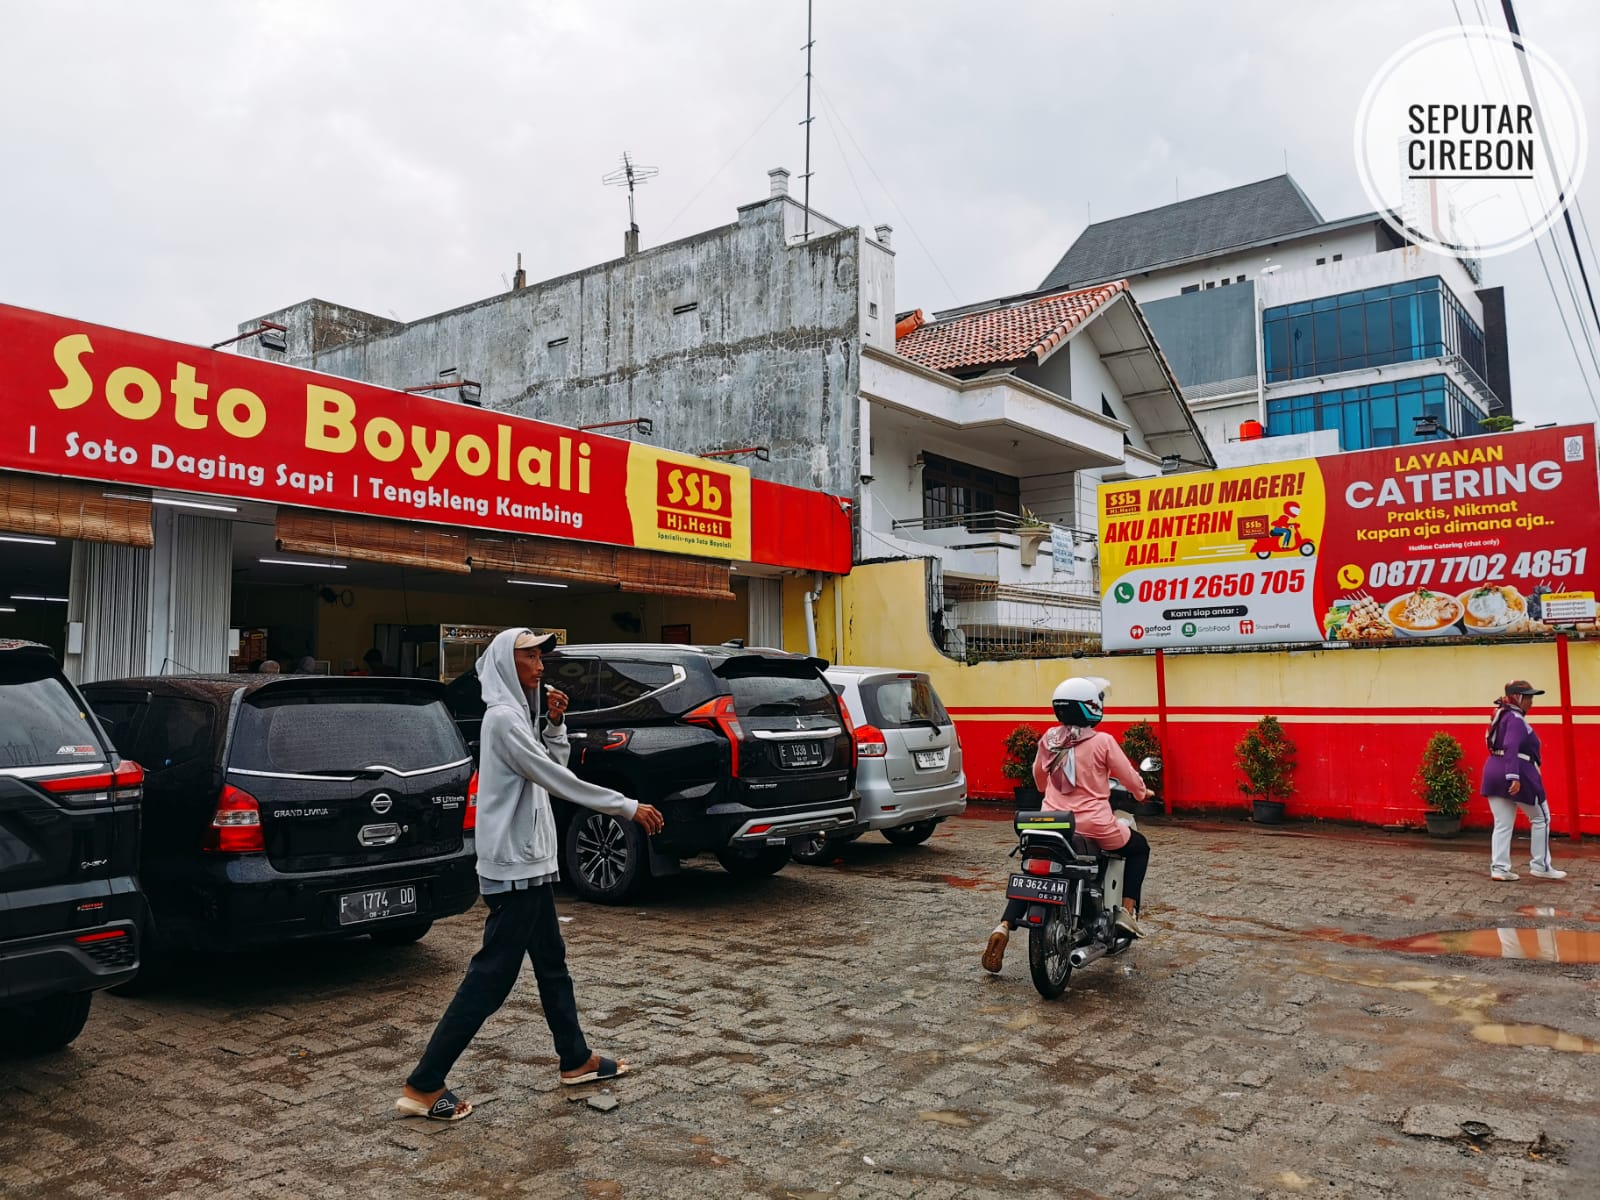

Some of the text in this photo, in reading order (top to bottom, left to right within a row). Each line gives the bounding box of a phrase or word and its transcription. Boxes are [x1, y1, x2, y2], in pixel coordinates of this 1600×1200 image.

[48, 333, 592, 495] Soto Boyolali
[1395, 445, 1504, 472] LAYANAN
[65, 431, 138, 465] Soto
[151, 444, 265, 487] Daging
[275, 463, 334, 496] Sapi
[369, 477, 489, 517] Tengkleng
[496, 496, 583, 528] Kambing
[667, 468, 722, 511] SSb
[1147, 472, 1306, 511] KALAU MAGER!
[1345, 460, 1563, 509] CATERING
[667, 513, 723, 535] Hj.Hesti
[1387, 500, 1518, 523] Praktis, Nikmat
[1104, 510, 1233, 543] AKU ANTERIN
[1356, 513, 1555, 543] Kapan aja dimana aja..
[1124, 541, 1178, 566] AJA..!
[1433, 541, 1463, 549] Catering
[1464, 539, 1482, 548] (chat
[1482, 538, 1500, 547] only)
[1368, 547, 1587, 588] 0877 7702 4851
[1138, 569, 1305, 602] 0811 2650 705
[1170, 610, 1192, 618] Kami
[1193, 608, 1211, 617] siap
[1211, 608, 1234, 616] antar
[1144, 624, 1171, 633] gofood
[1198, 625, 1230, 633] GrabFood
[274, 808, 328, 818] GRAND LIVINA
[1012, 877, 1064, 893] DR 3624 AM
[341, 887, 414, 913] F 1774 DD
